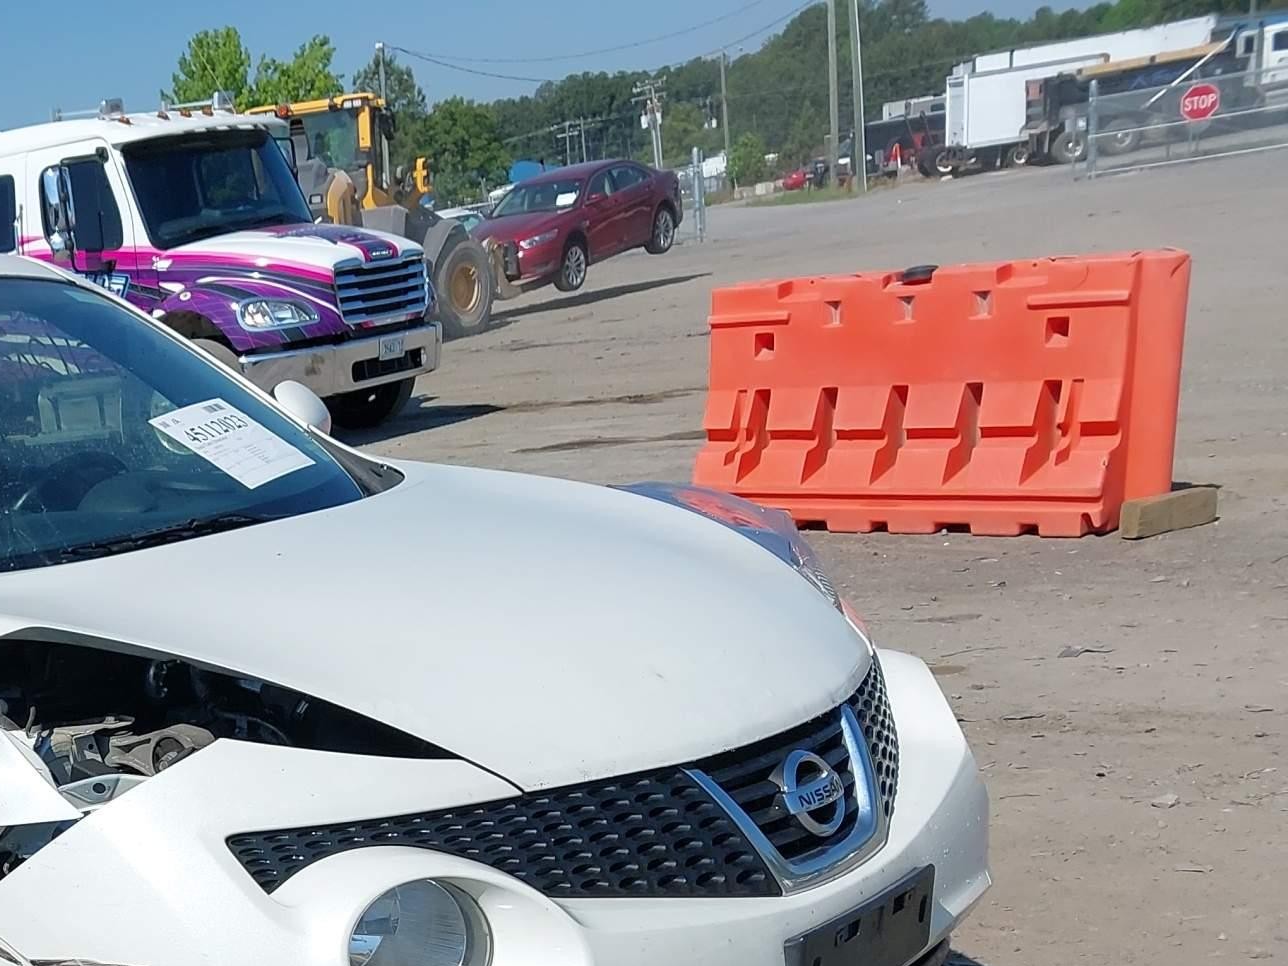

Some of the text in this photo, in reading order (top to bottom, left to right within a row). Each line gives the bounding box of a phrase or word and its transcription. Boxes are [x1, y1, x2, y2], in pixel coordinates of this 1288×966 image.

[1183, 93, 1217, 112] STOP
[184, 414, 249, 444] 45112023
[798, 776, 842, 808] NISSAN
